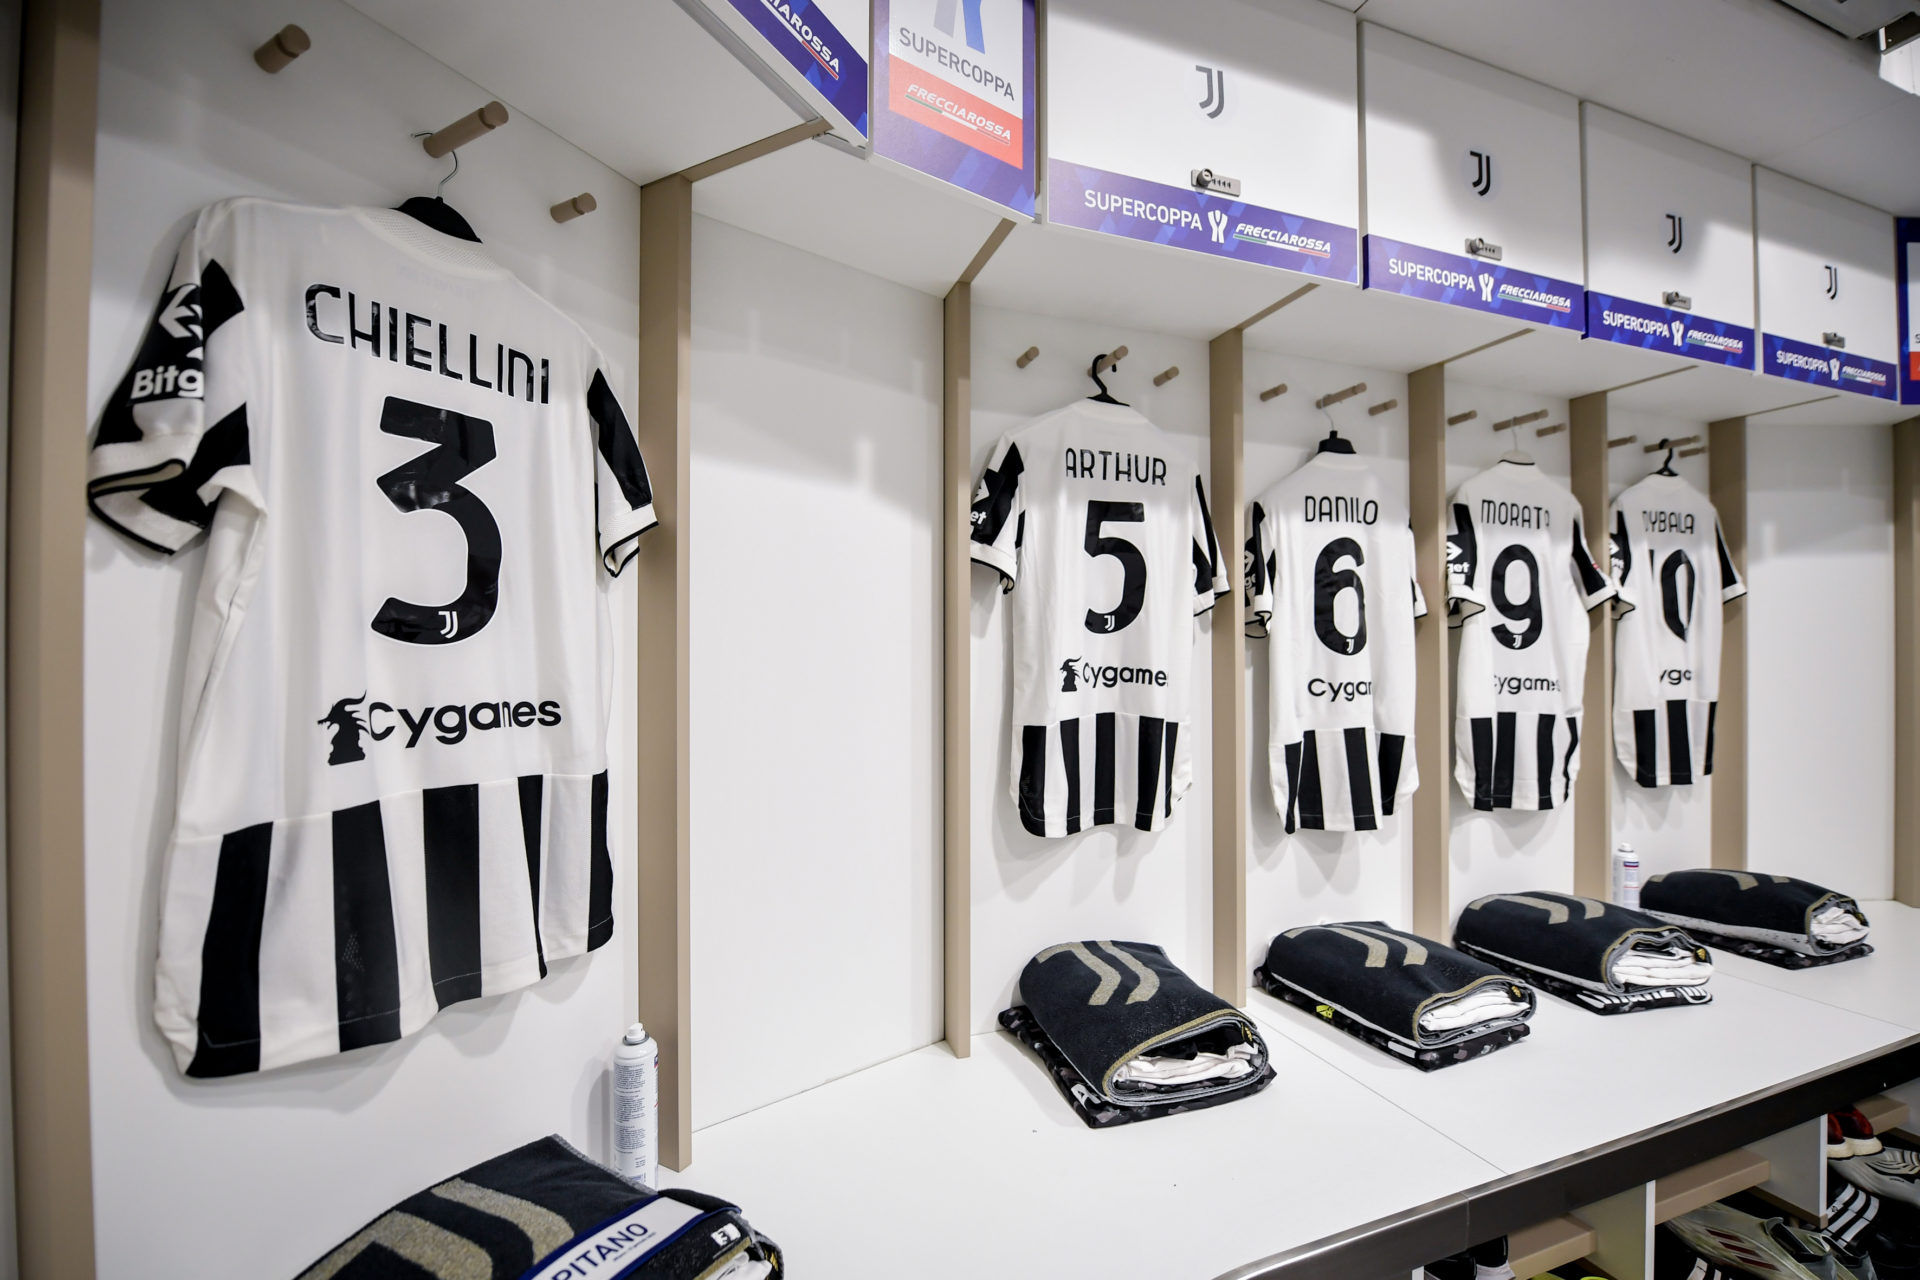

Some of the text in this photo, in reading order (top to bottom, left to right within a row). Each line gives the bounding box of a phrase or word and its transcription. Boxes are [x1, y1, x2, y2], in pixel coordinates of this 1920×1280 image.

[770, 0, 839, 73] IAROSSA
[899, 27, 1015, 101] SUPERCOPPA
[907, 84, 1012, 141] FRECCIAROSSA
[1084, 189, 1332, 254] SUPERCOPPA FRECCIAROSSA
[1388, 258, 1572, 308] SUPERCOPPA FRECCIAROSSA
[305, 284, 549, 404] CHIELLINI
[1603, 310, 1744, 349] SUPERCOPPA FRECCIAROSSA
[1776, 350, 1830, 374] SUPERCOPPA
[1065, 447, 1167, 486] ARTHUR
[371, 395, 502, 645] 3
[1304, 495, 1379, 526] DANILO
[1084, 499, 1147, 635] 5
[1313, 536, 1367, 657] 6
[1490, 543, 1543, 651] 9
[1649, 549, 1695, 643] 0
[1082, 662, 1169, 689] Cygame
